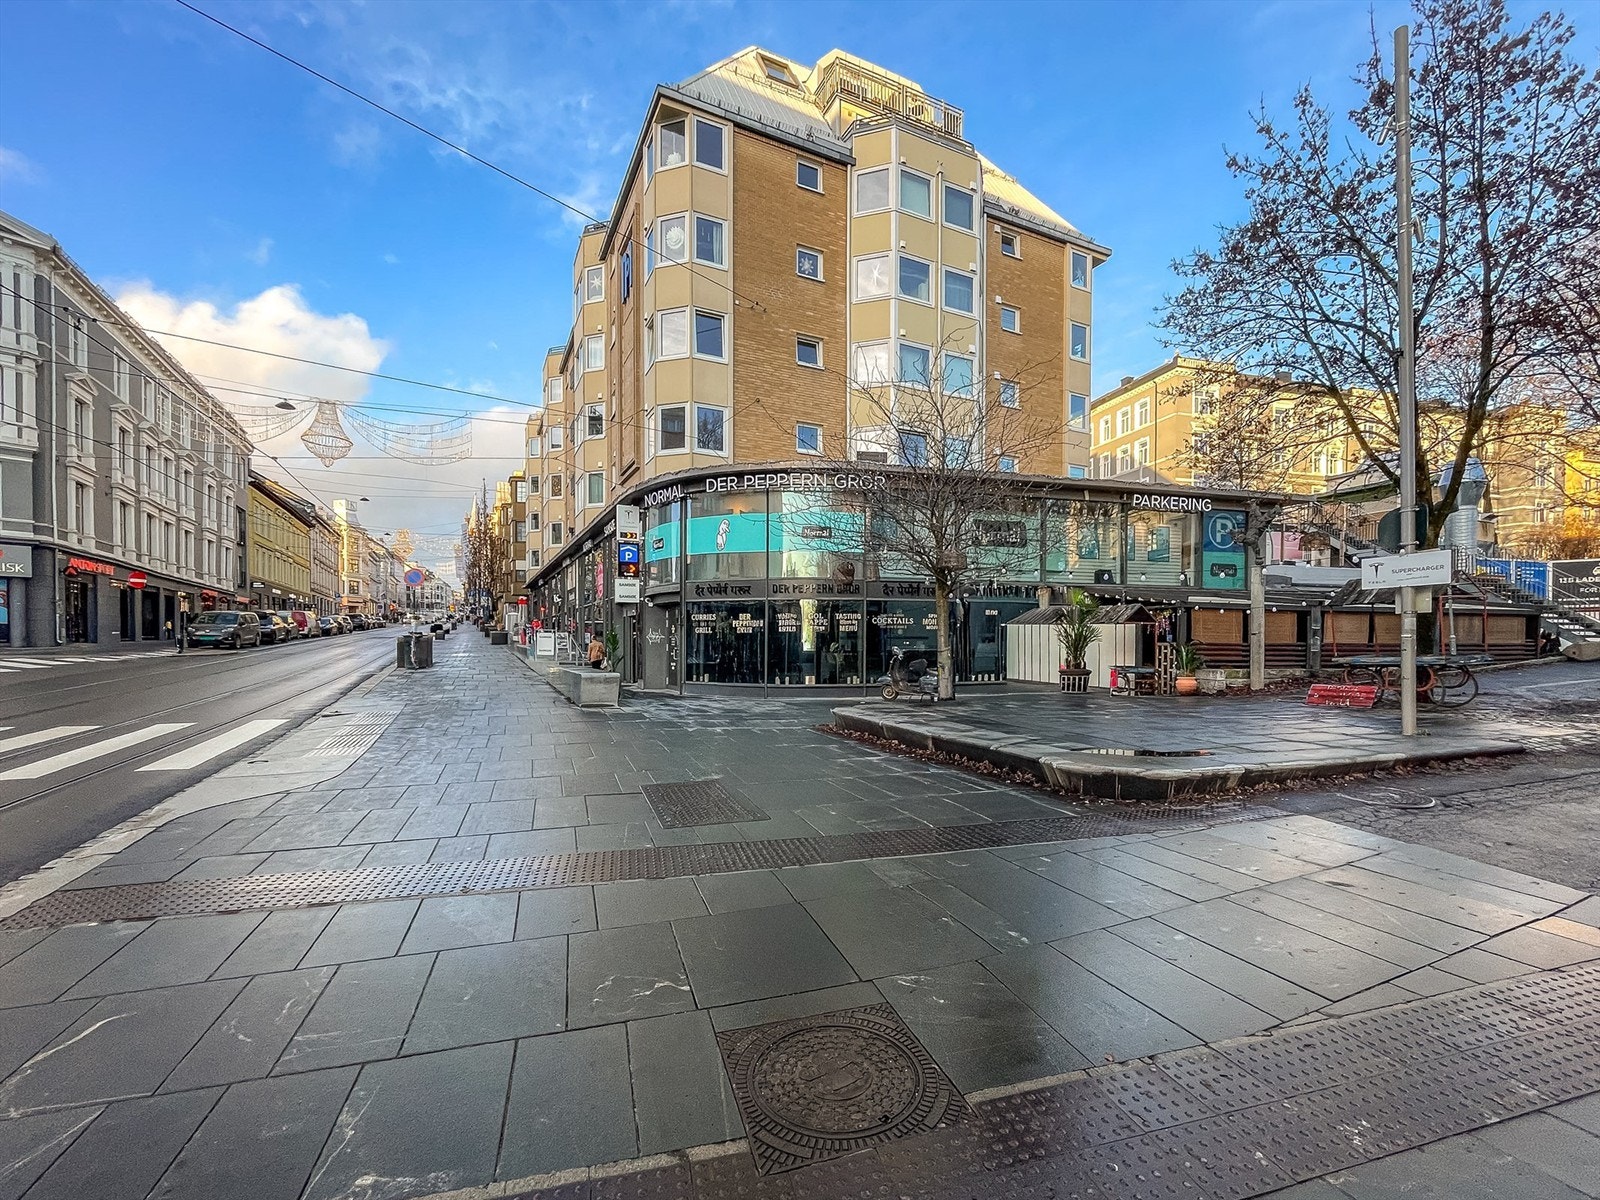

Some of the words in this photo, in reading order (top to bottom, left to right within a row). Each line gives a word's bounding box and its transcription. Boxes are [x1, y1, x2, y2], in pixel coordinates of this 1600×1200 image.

[706, 476, 738, 492] DER
[744, 473, 827, 489] PEPPERN
[644, 484, 685, 507] NORMAL
[1132, 494, 1212, 512] PARKERING
[625, 551, 633, 561] P
[0, 562, 25, 573] ISK
[1391, 564, 1445, 574] SUPERCHARGER
[772, 583, 790, 594] DER
[792, 583, 834, 594] PEPPERN
[871, 617, 914, 625] COCKTAILS
[694, 626, 713, 634] GRILL
